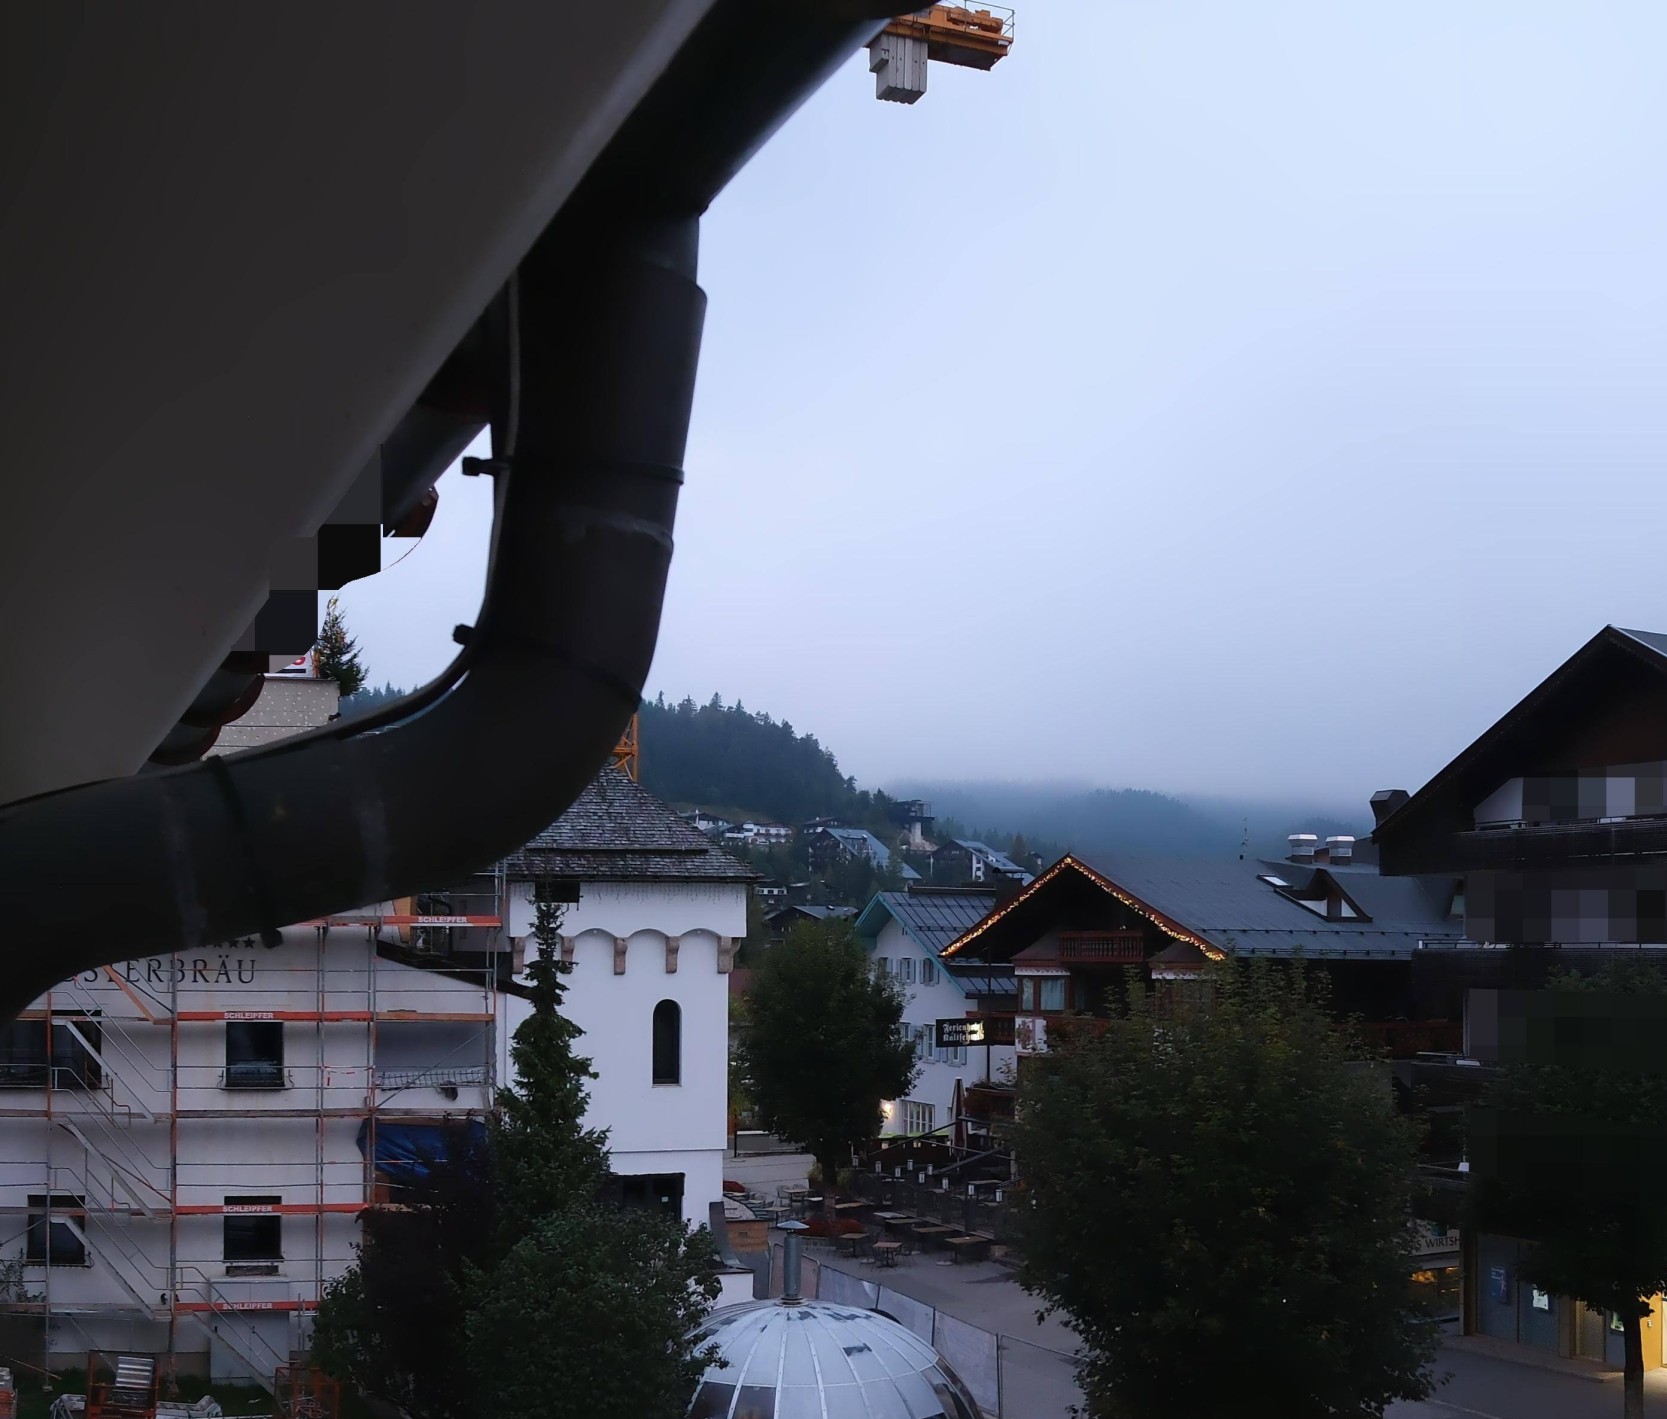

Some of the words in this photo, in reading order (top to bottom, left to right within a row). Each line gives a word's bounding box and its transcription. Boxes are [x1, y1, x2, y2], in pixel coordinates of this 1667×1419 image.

[417, 915, 467, 924] SCHLEIPFER
[63, 954, 256, 984] STERBRÄU
[224, 1011, 274, 1020] SCHLEIPFER
[222, 1204, 273, 1213] SCHLEIPFER
[222, 1301, 273, 1310] SCHLEIPFER
